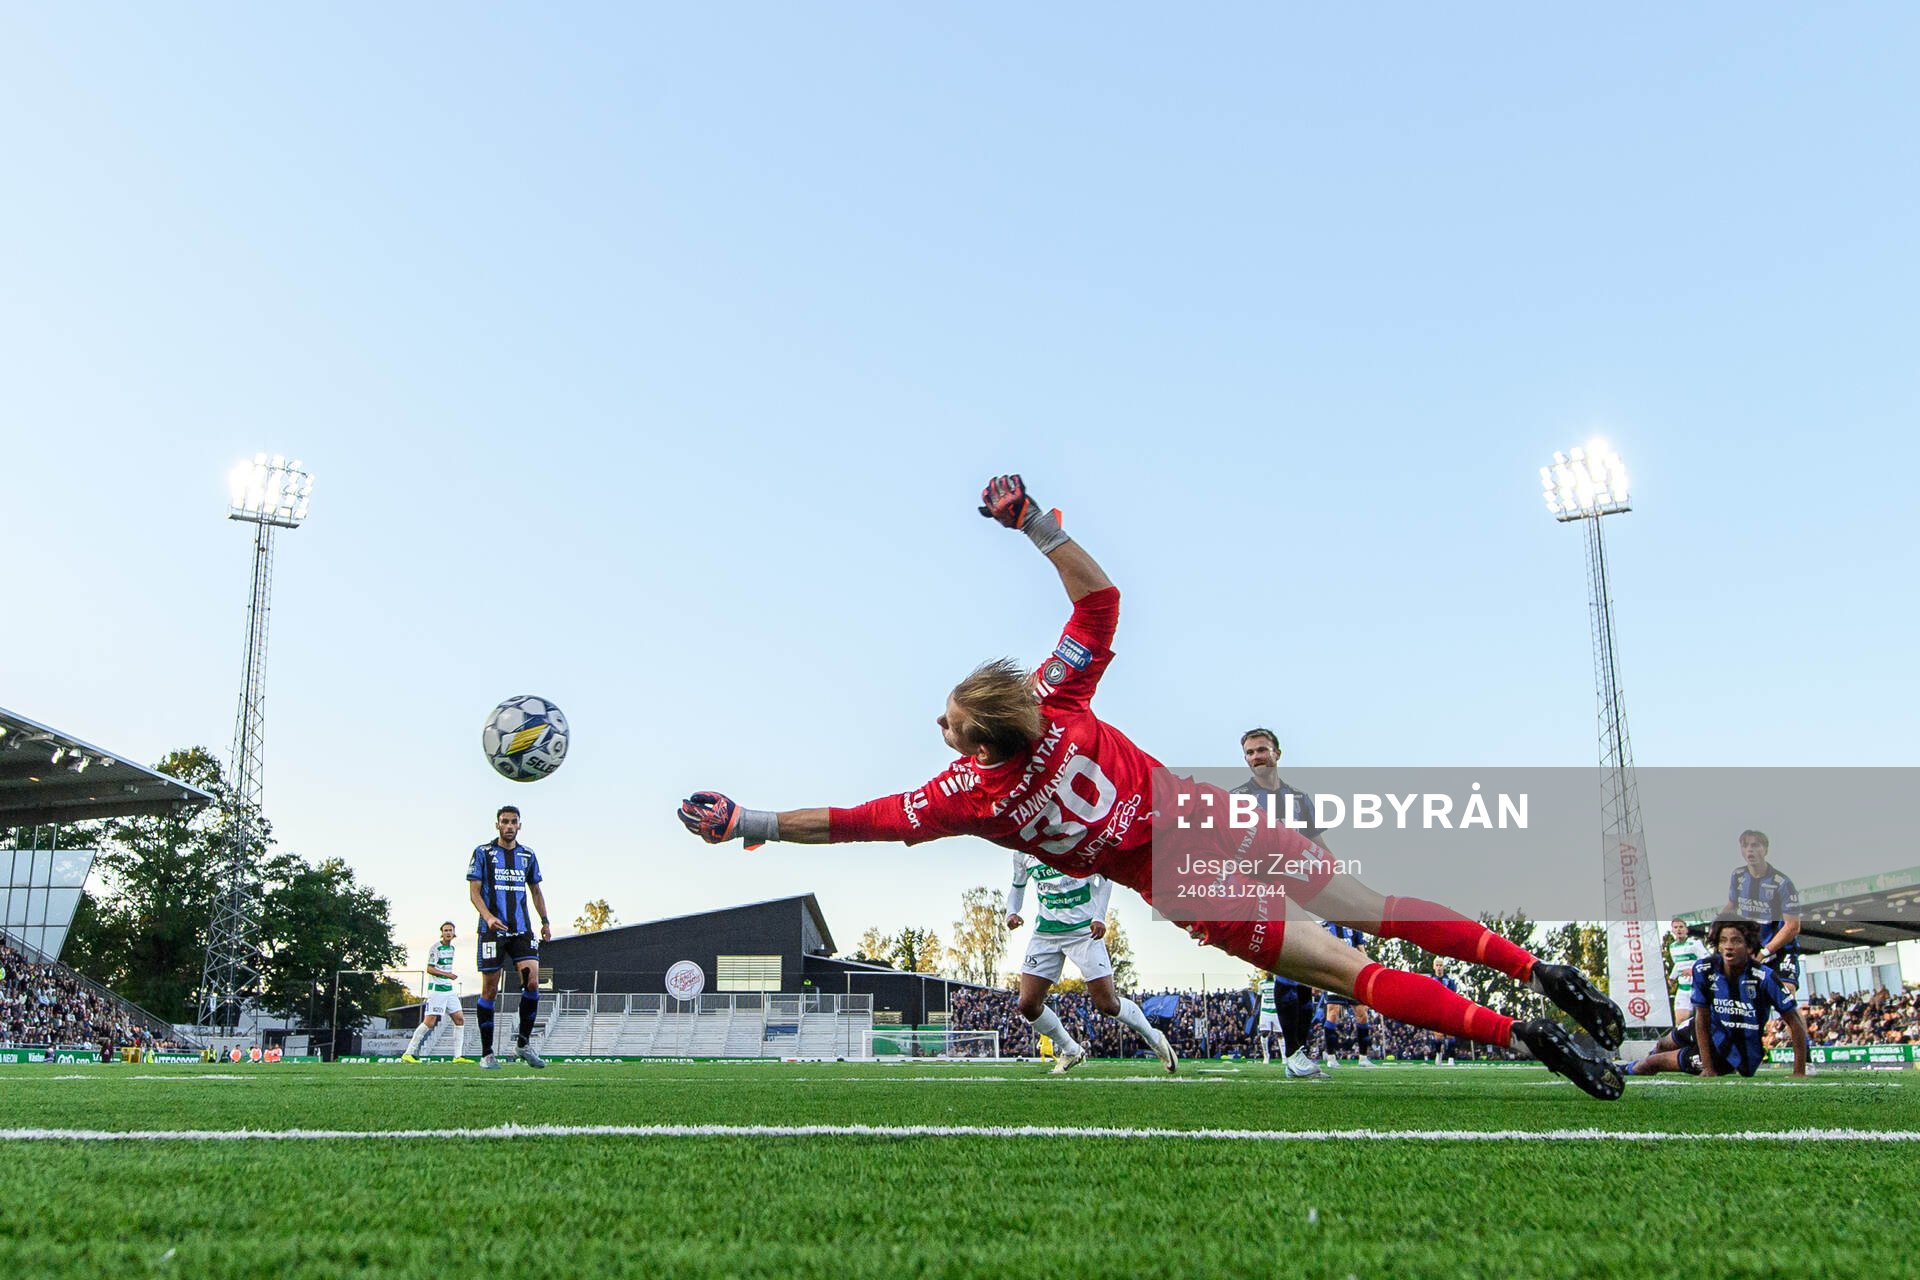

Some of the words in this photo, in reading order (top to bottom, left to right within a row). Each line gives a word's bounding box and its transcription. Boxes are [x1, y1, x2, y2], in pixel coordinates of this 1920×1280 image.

[1037, 721, 1067, 758] TAK
[1019, 754, 1118, 855] 30
[1620, 842, 1638, 915] Energy
[1624, 919, 1646, 993] Hitachi
[1713, 998, 1734, 1007] BYGG
[1714, 1005, 1756, 1018] CONSTRUCT
